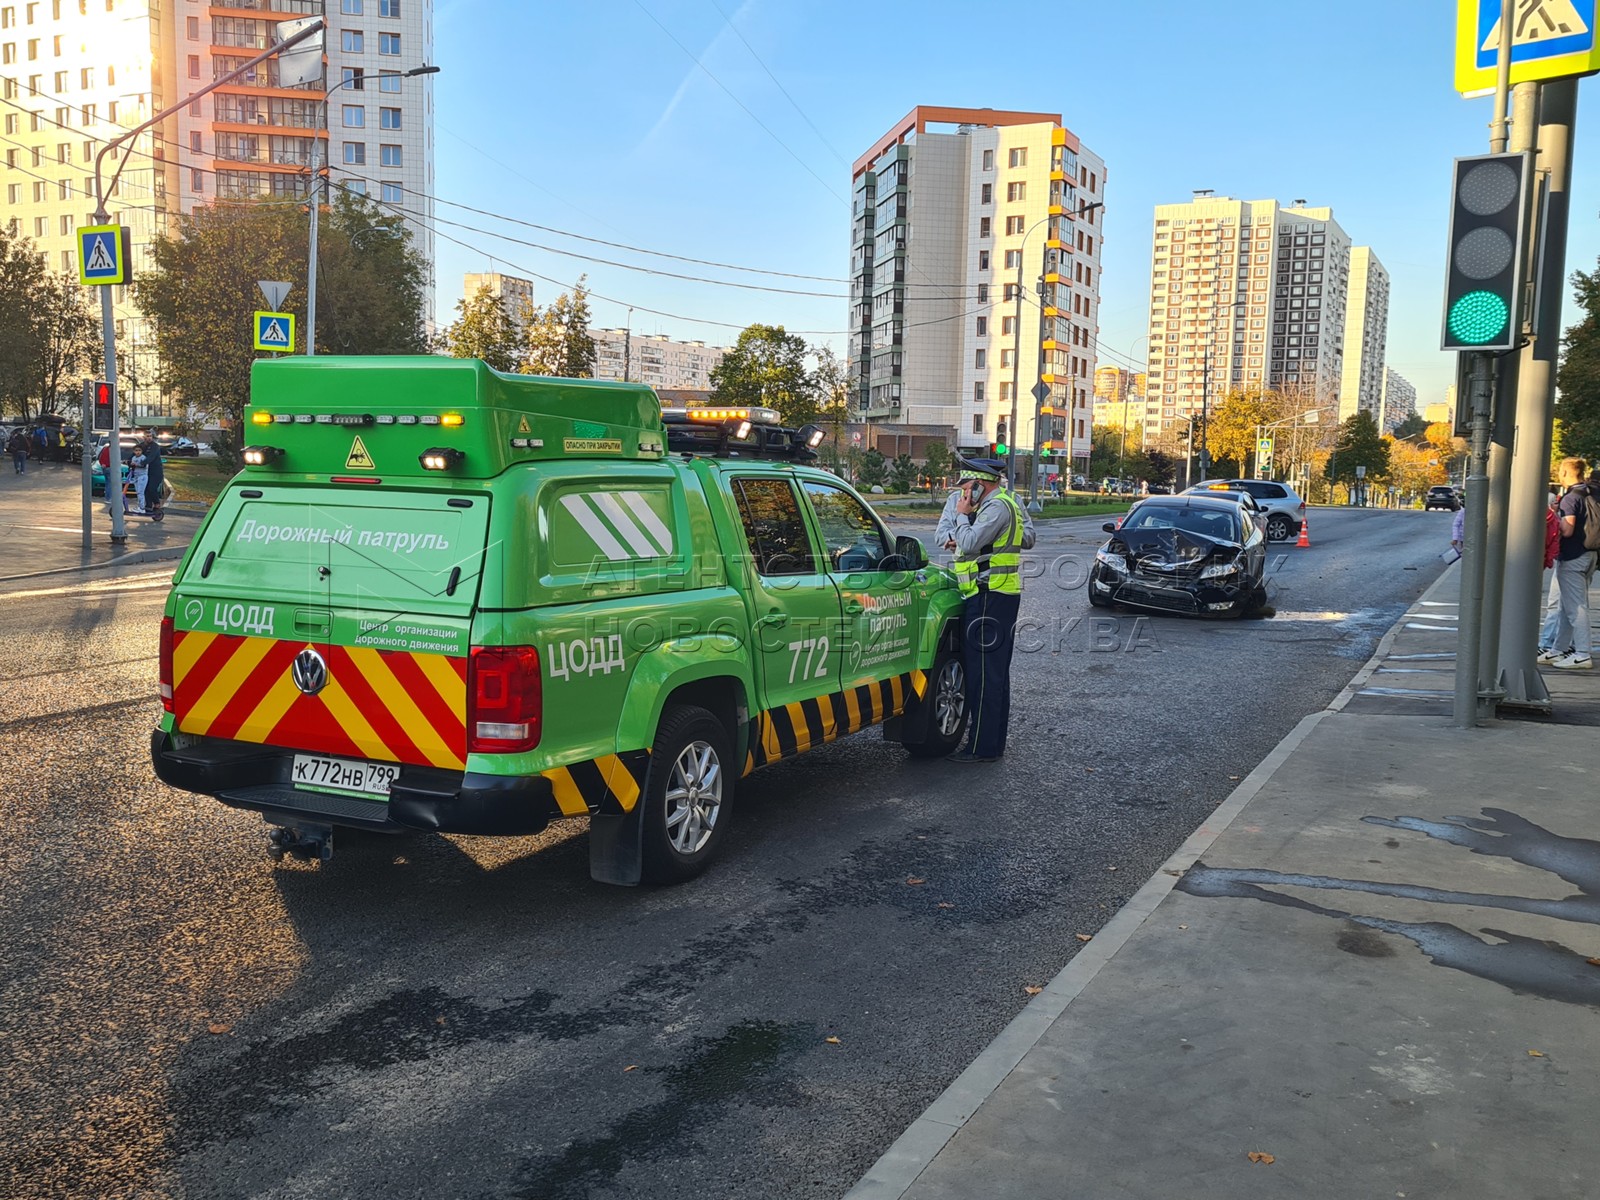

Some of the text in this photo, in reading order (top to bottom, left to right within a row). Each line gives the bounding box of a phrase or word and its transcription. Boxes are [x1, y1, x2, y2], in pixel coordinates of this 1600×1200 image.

[565, 440, 621, 450] ОПАСНО ПРИ ЗАКРЫТИИ
[236, 519, 449, 554] Дорожный патруль
[863, 587, 912, 616] Дорожный
[213, 602, 275, 635] ЦОДД
[869, 613, 908, 634] патруль
[359, 620, 458, 639] Центр организации
[355, 635, 459, 653] дорожного движения
[547, 633, 625, 682] ЦОДД
[788, 636, 830, 684] 772
[368, 764, 395, 785] 799
[371, 783, 386, 791] RUS
